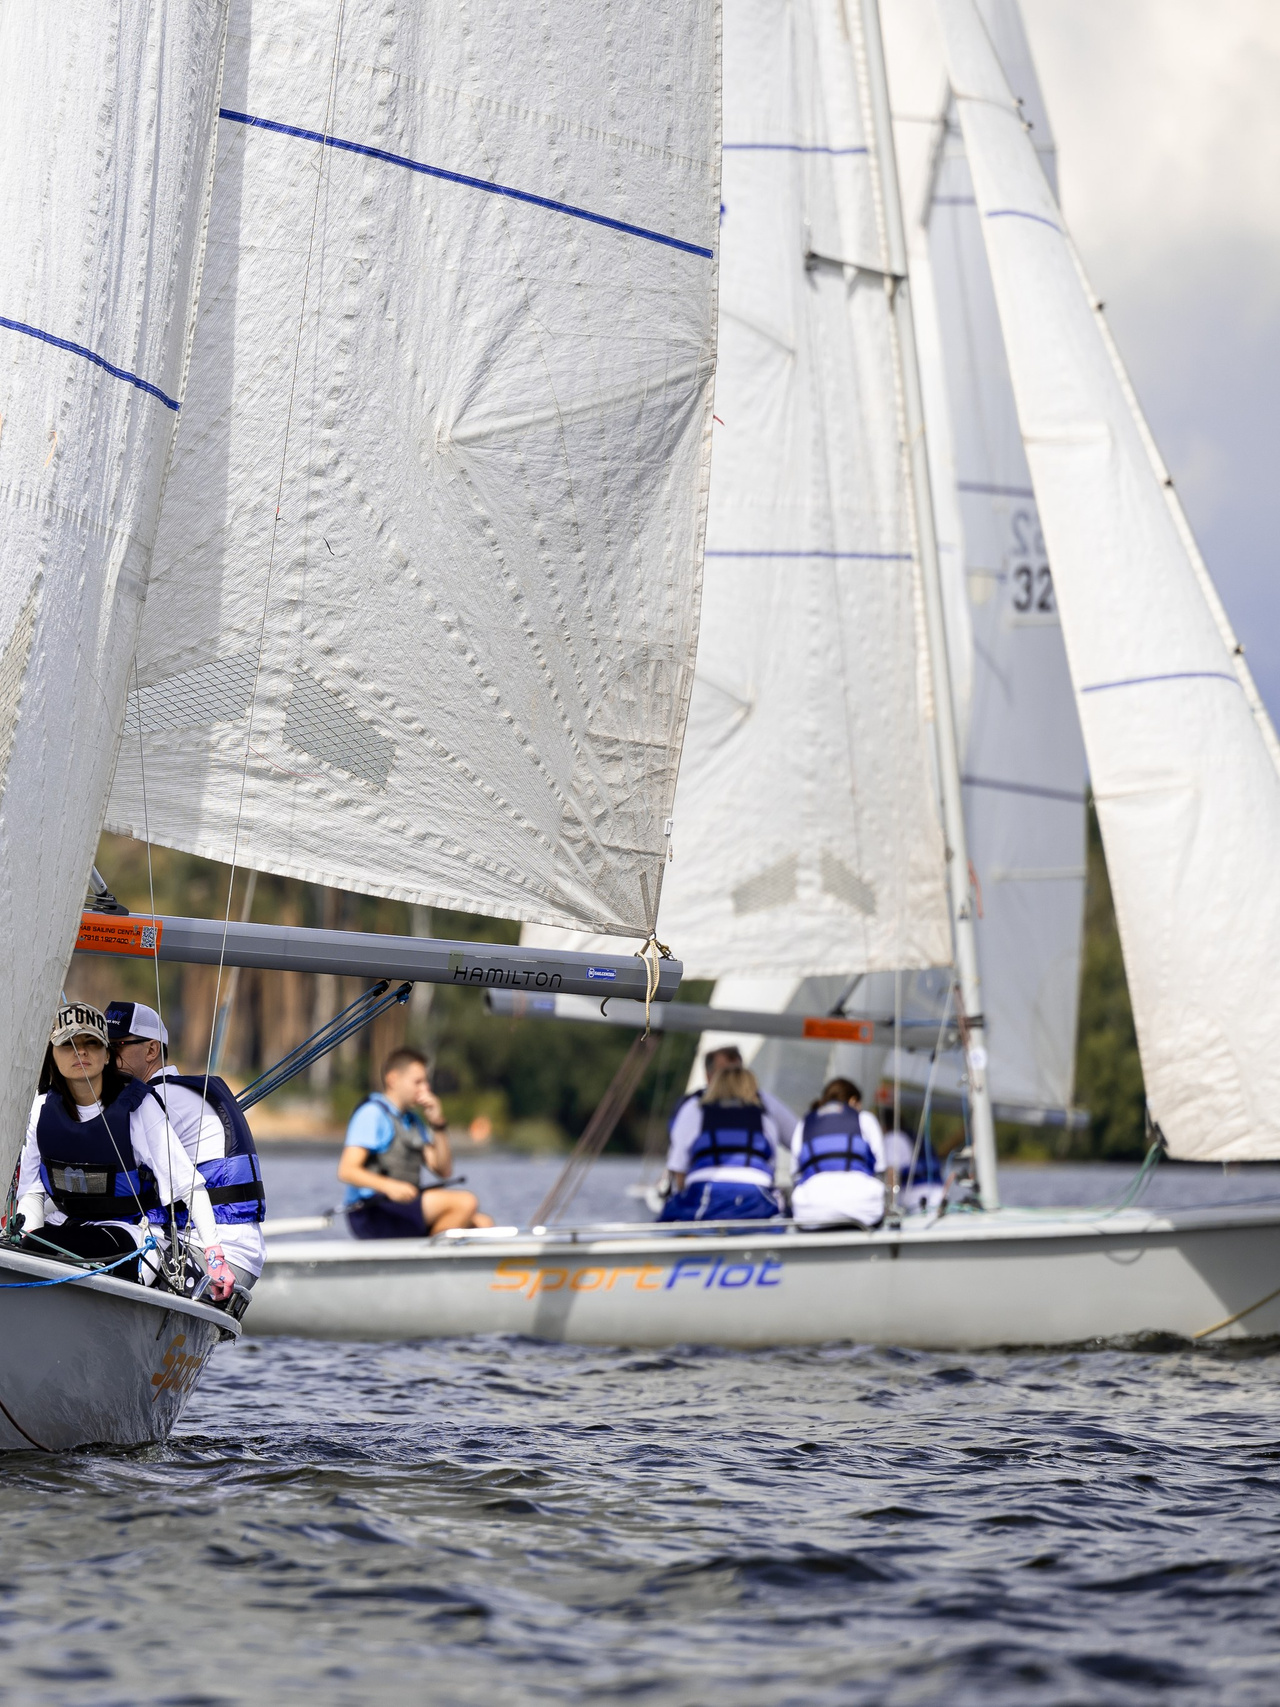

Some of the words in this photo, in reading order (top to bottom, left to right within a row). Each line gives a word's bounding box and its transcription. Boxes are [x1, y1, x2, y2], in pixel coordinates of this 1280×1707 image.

[92, 926, 116, 934] SAILING
[453, 965, 563, 988] HAMILTON
[489, 1256, 783, 1300] SportFlot
